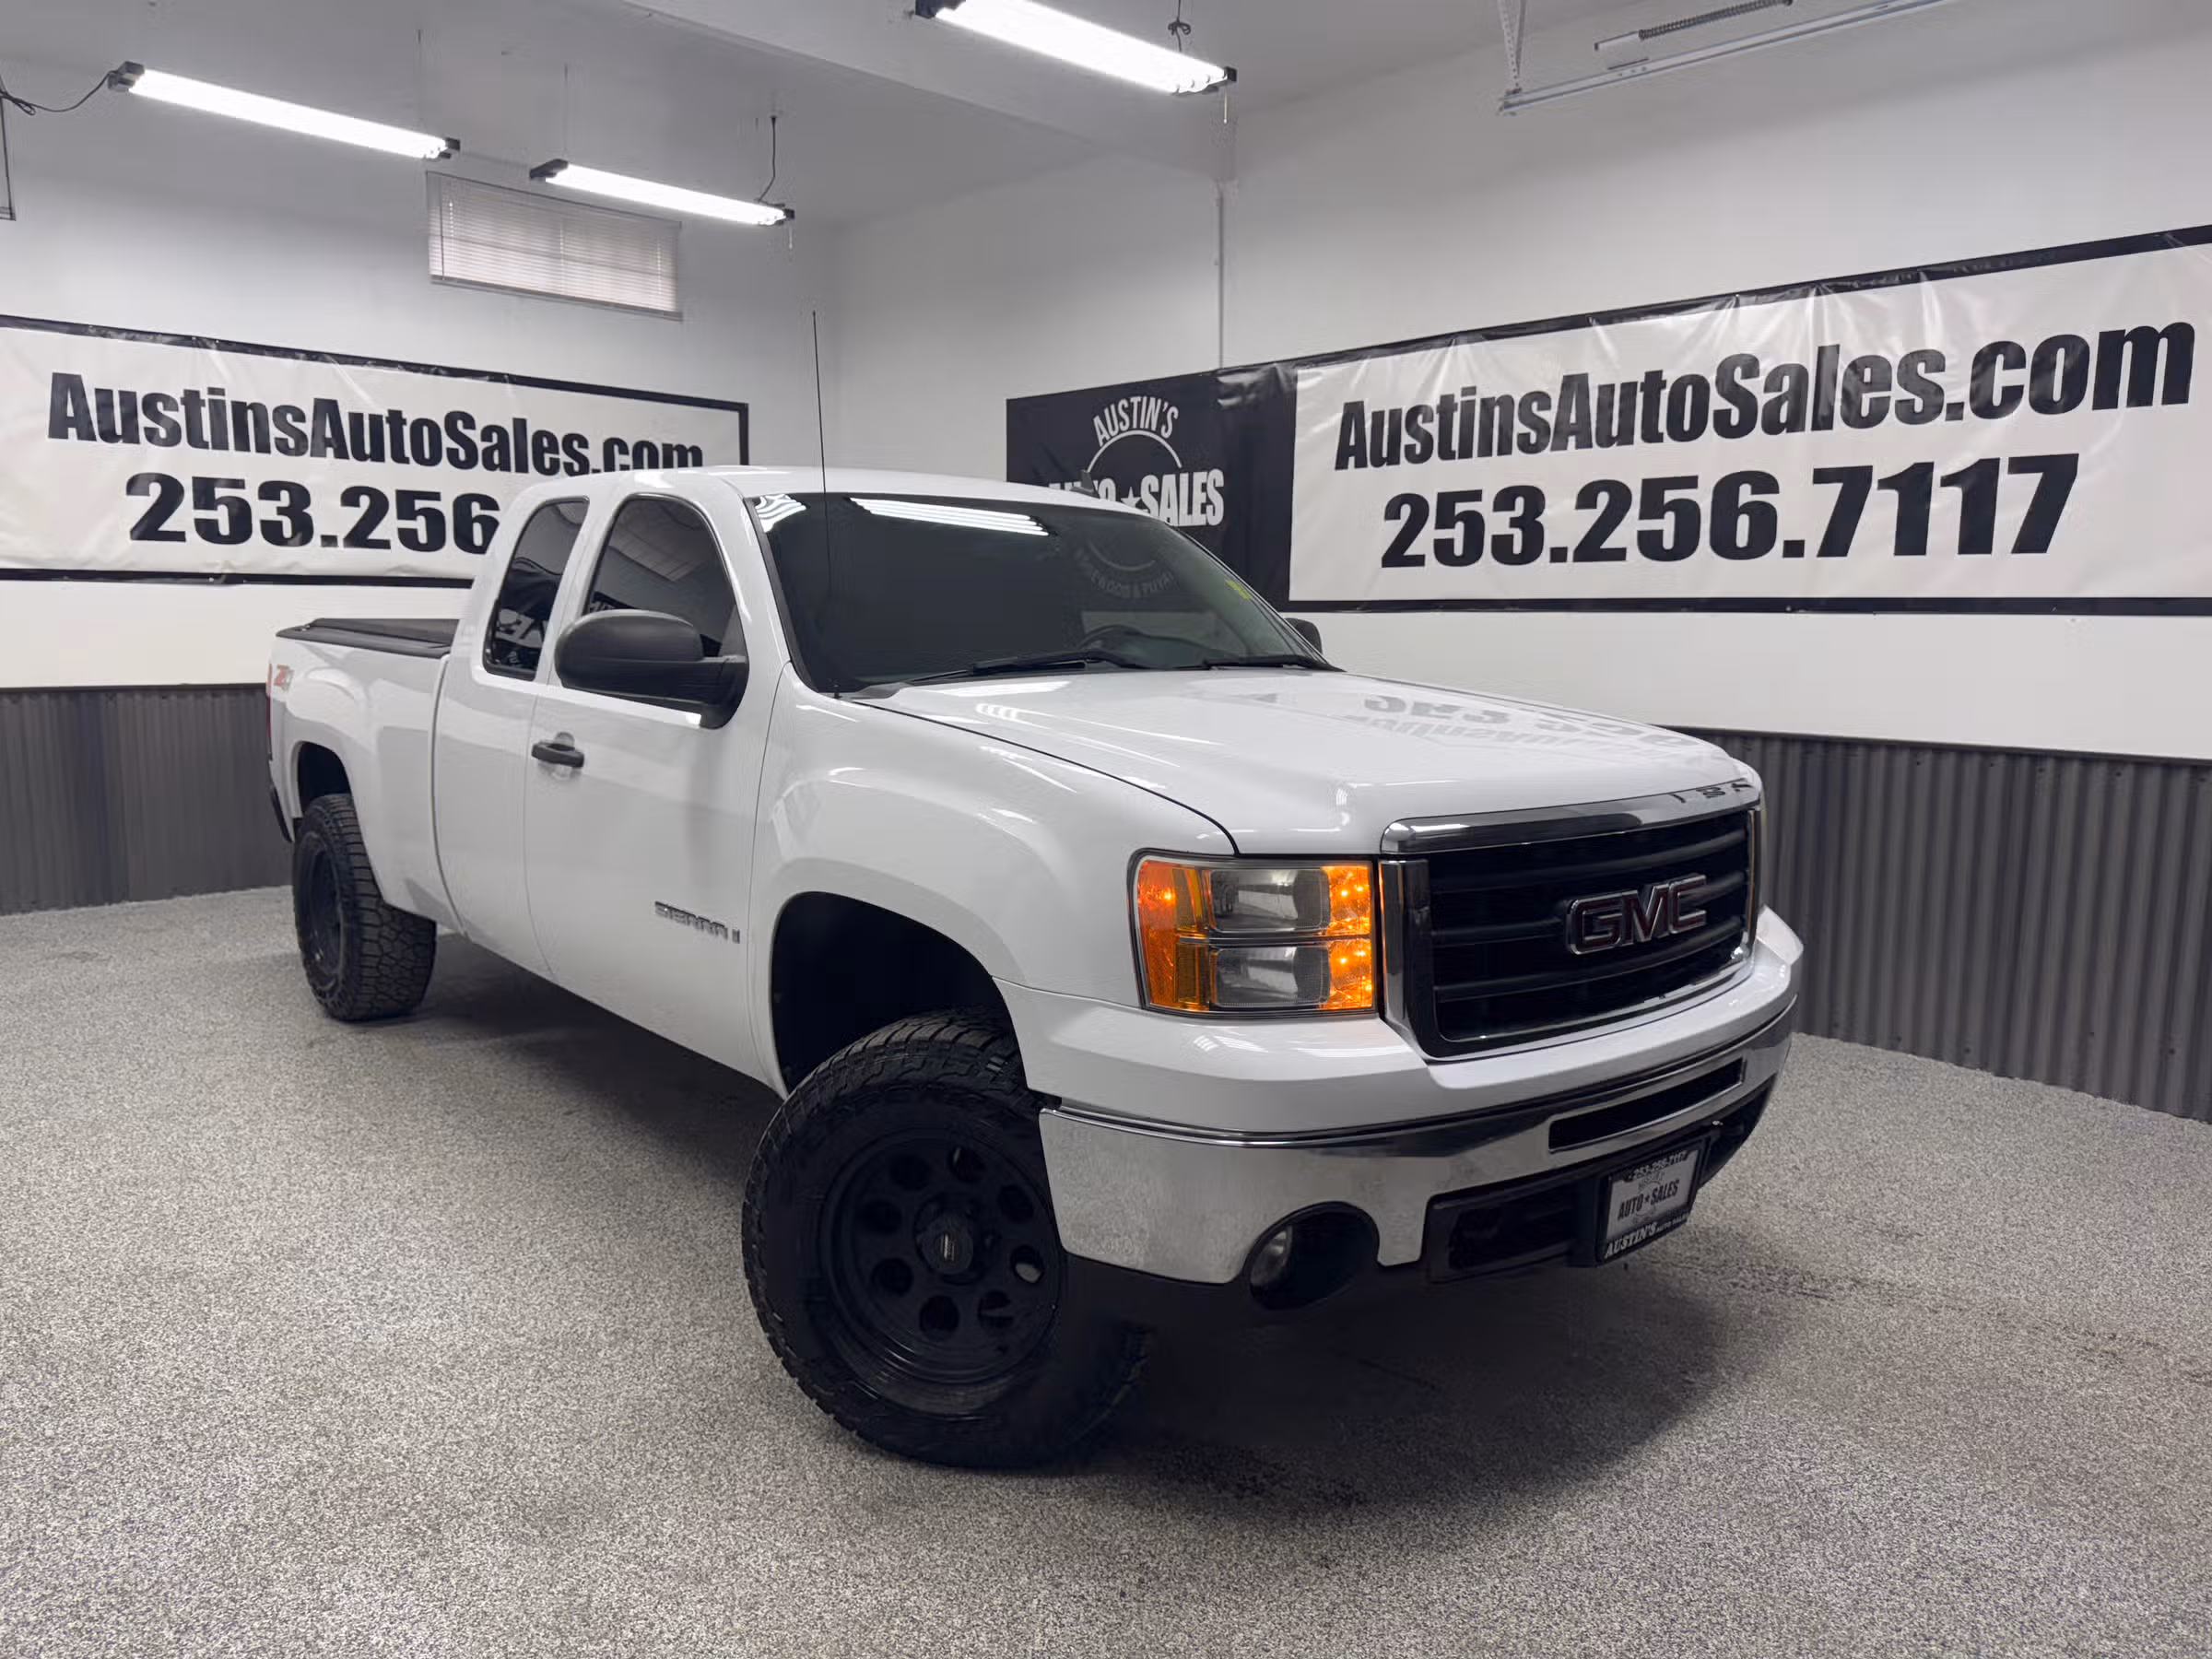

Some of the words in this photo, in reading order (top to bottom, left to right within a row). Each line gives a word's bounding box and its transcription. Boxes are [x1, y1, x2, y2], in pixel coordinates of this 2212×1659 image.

[1093, 395, 1179, 446] AUSTIN'S
[1335, 321, 2194, 470] AustinsAutoSales.com
[1140, 468, 1224, 526] SALES
[1382, 453, 2079, 568] 253.256.7117
[1567, 874, 1707, 955] GMC
[1618, 1194, 1644, 1221] AUTO
[1651, 1179, 1679, 1205] SALES
[1604, 1222, 1657, 1259] AUSTIN'S
